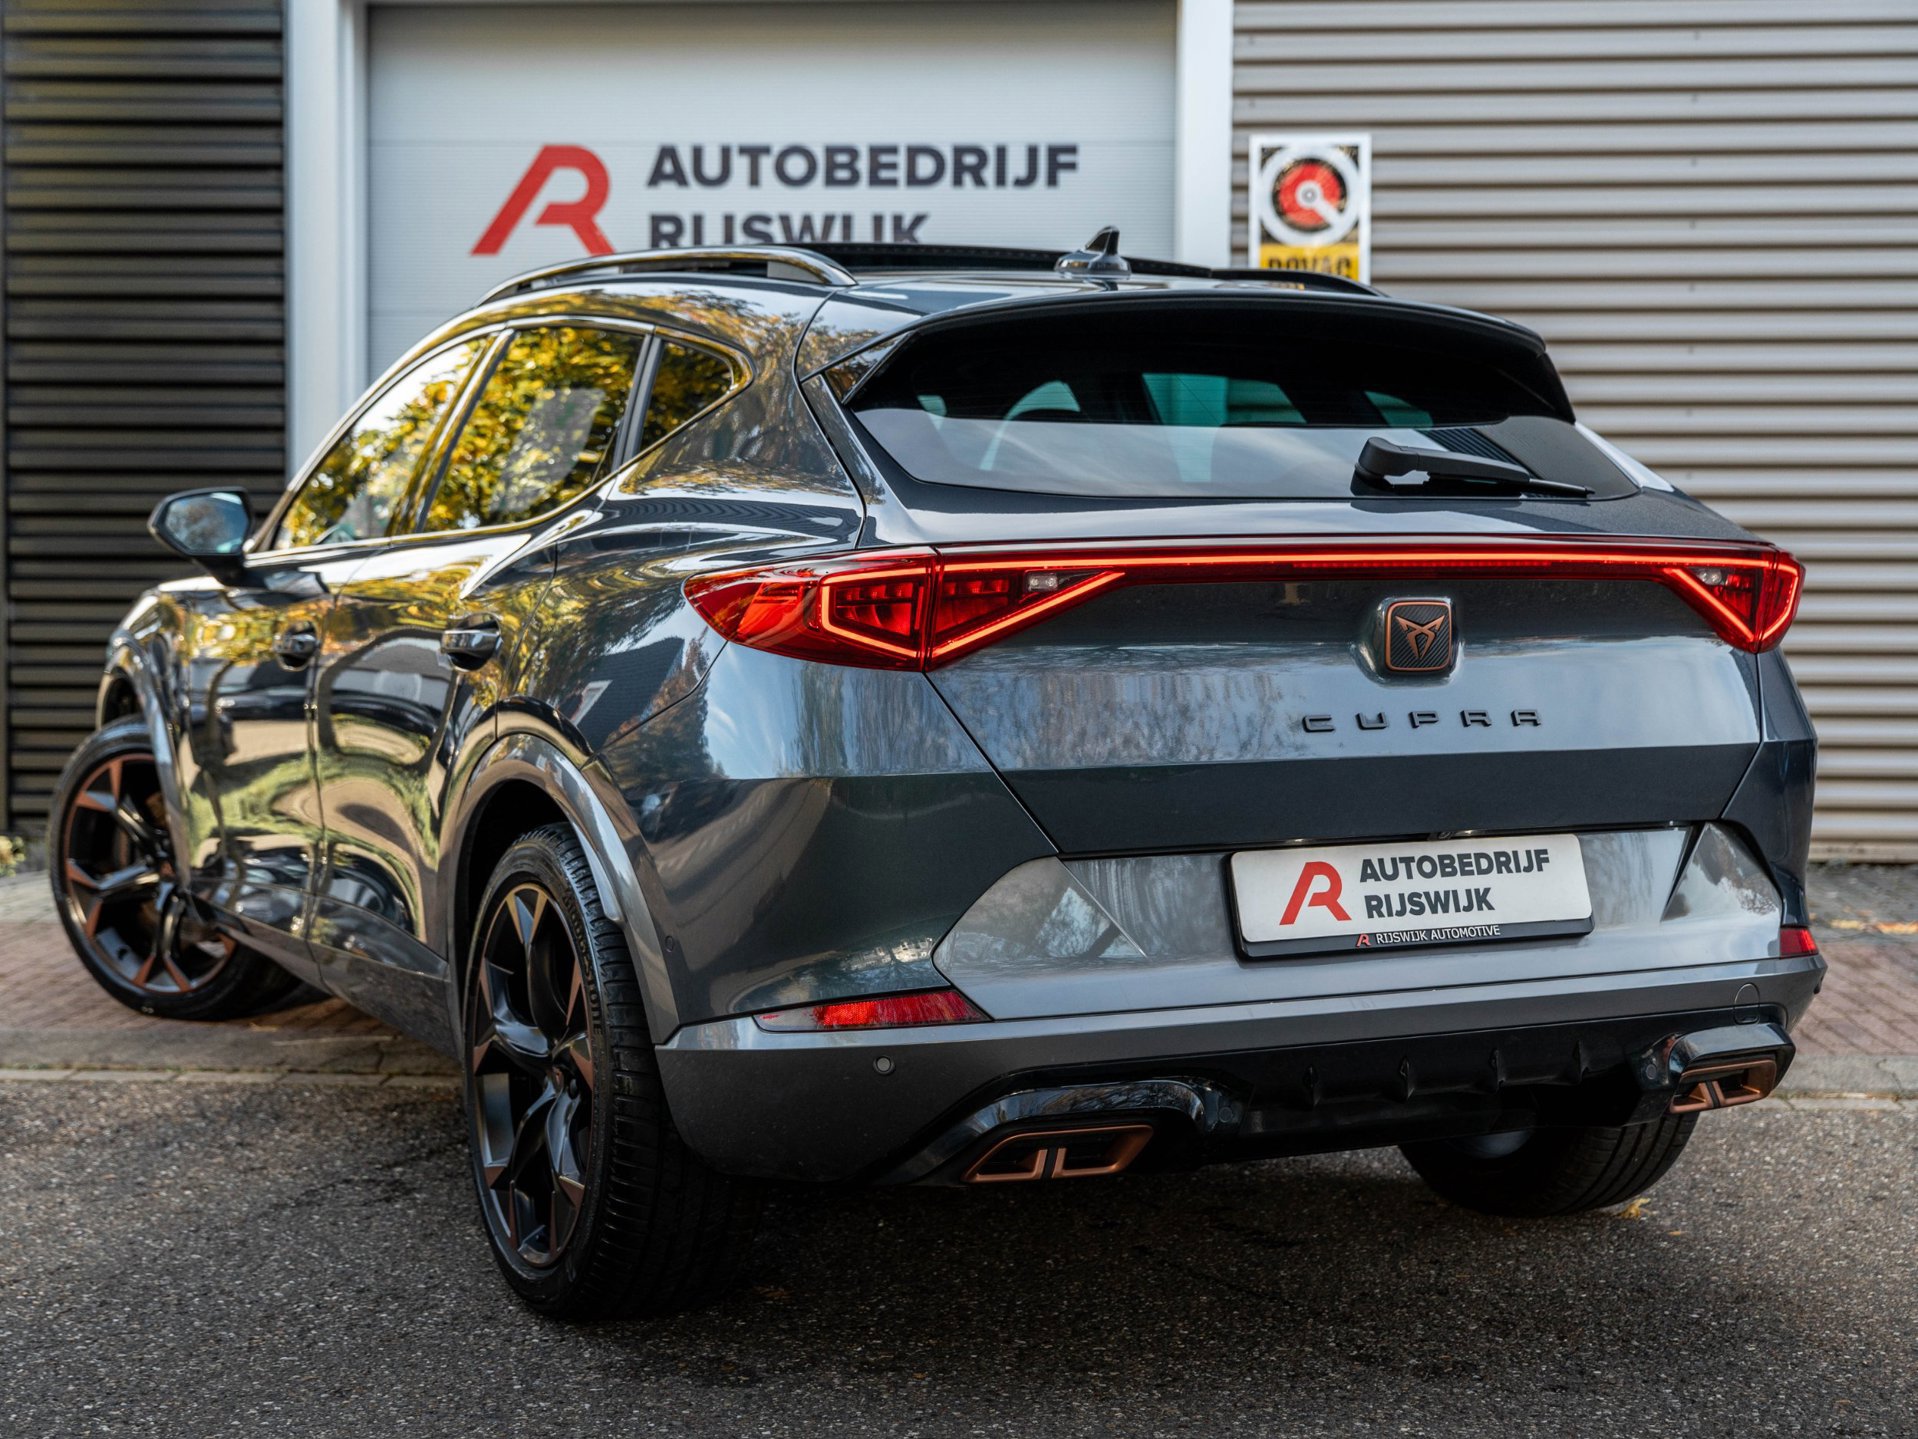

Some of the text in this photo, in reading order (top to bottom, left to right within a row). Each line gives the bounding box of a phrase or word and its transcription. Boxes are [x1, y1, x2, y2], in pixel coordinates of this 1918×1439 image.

[647, 145, 1079, 188] AUTOBEDRIJF
[1302, 709, 1542, 733] CUPRA
[1359, 848, 1550, 883] AUTOBEDRIJF
[1364, 887, 1496, 919] RIJSWIJK
[1376, 929, 1427, 944] RIJSWIJK
[1430, 924, 1501, 941] AUTOMOTIVE
